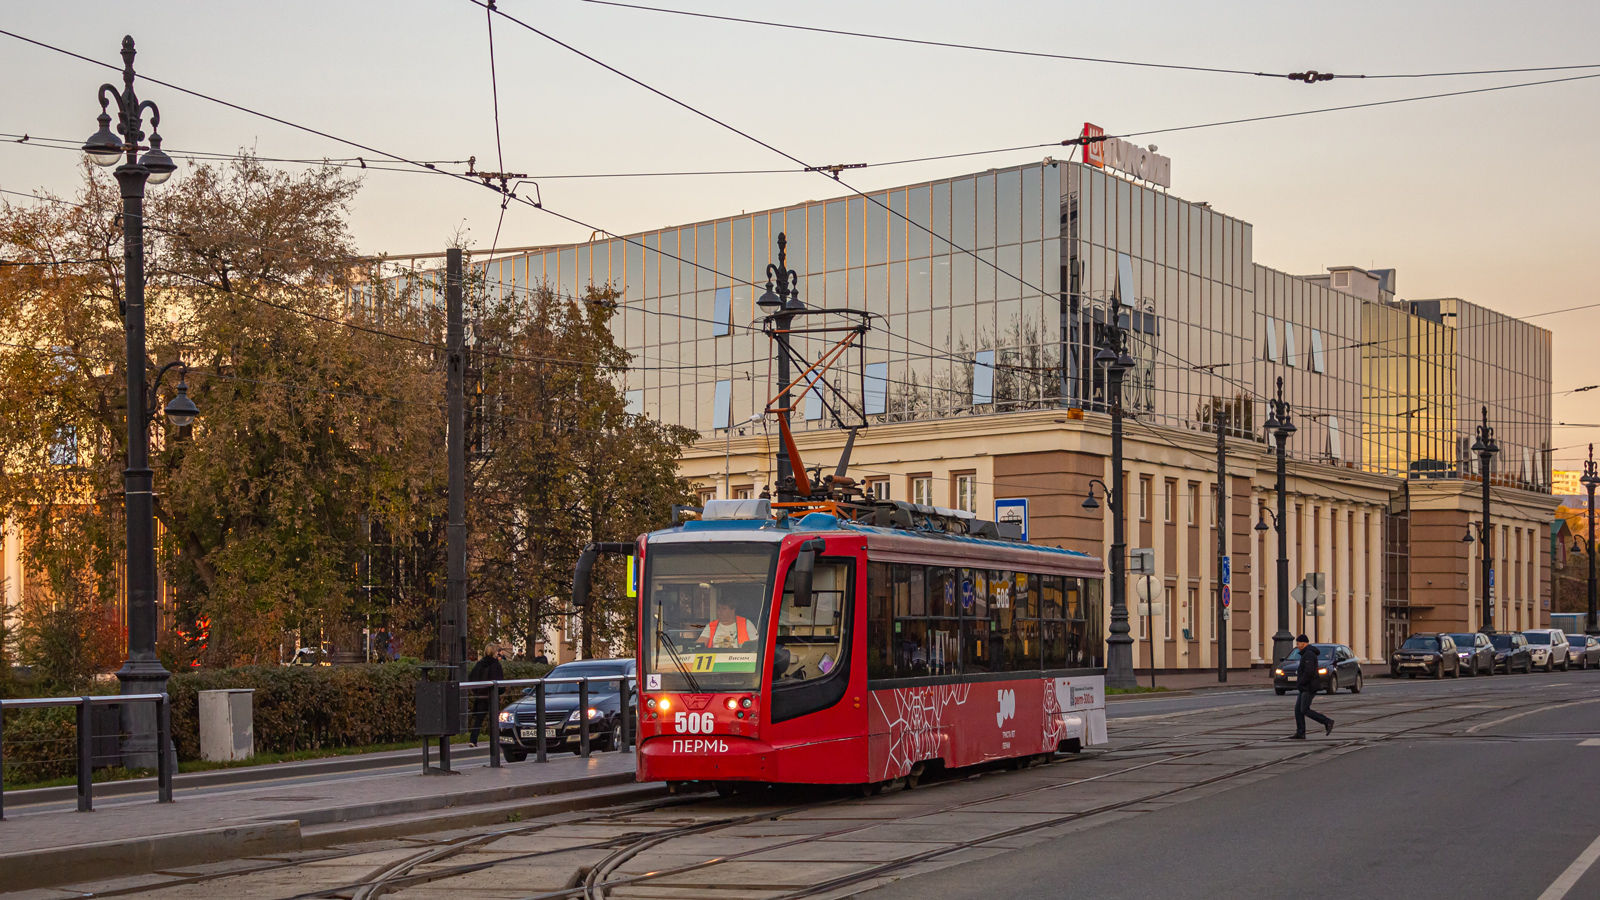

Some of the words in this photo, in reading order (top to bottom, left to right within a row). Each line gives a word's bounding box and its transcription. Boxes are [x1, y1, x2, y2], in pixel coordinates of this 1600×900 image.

[996, 587, 1009, 609] 506
[696, 656, 713, 670] 11
[675, 712, 715, 734] 506
[672, 739, 729, 753] ПЕРМЬ
